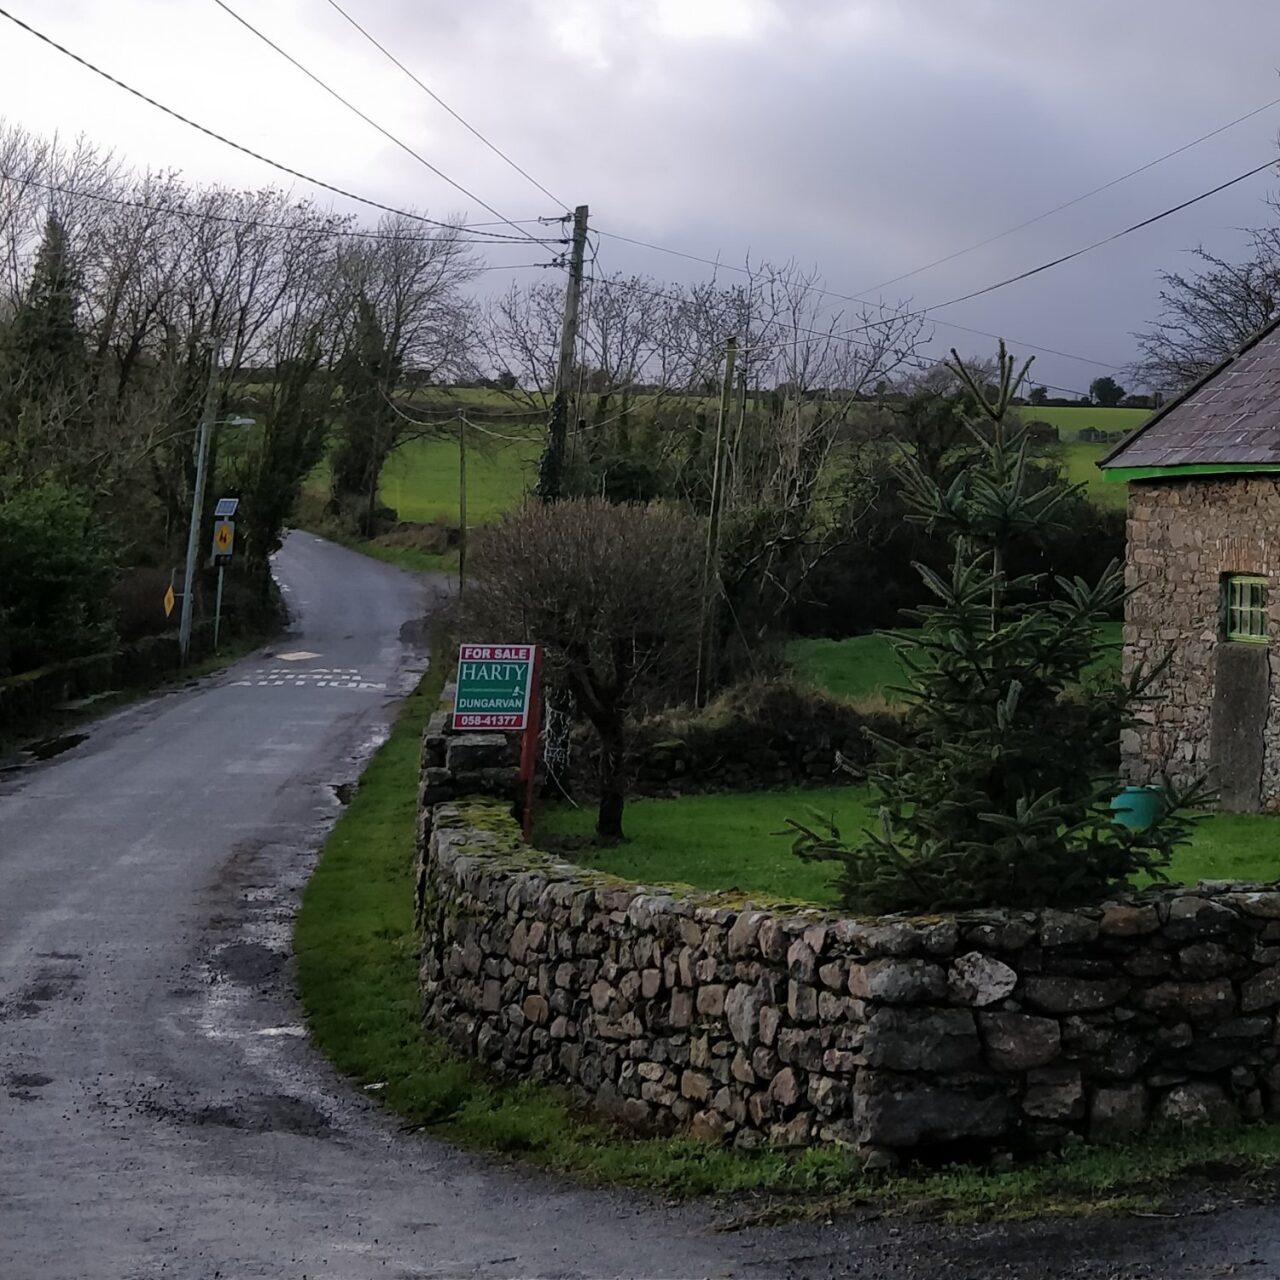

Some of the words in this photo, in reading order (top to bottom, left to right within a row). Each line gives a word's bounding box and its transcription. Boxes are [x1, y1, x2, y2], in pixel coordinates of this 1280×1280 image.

[464, 648, 491, 659] FOR
[494, 648, 527, 659] SALE
[461, 663, 527, 680] HARTY
[459, 698, 522, 708] DUNGARVAN
[461, 715, 517, 726] 058-41377
